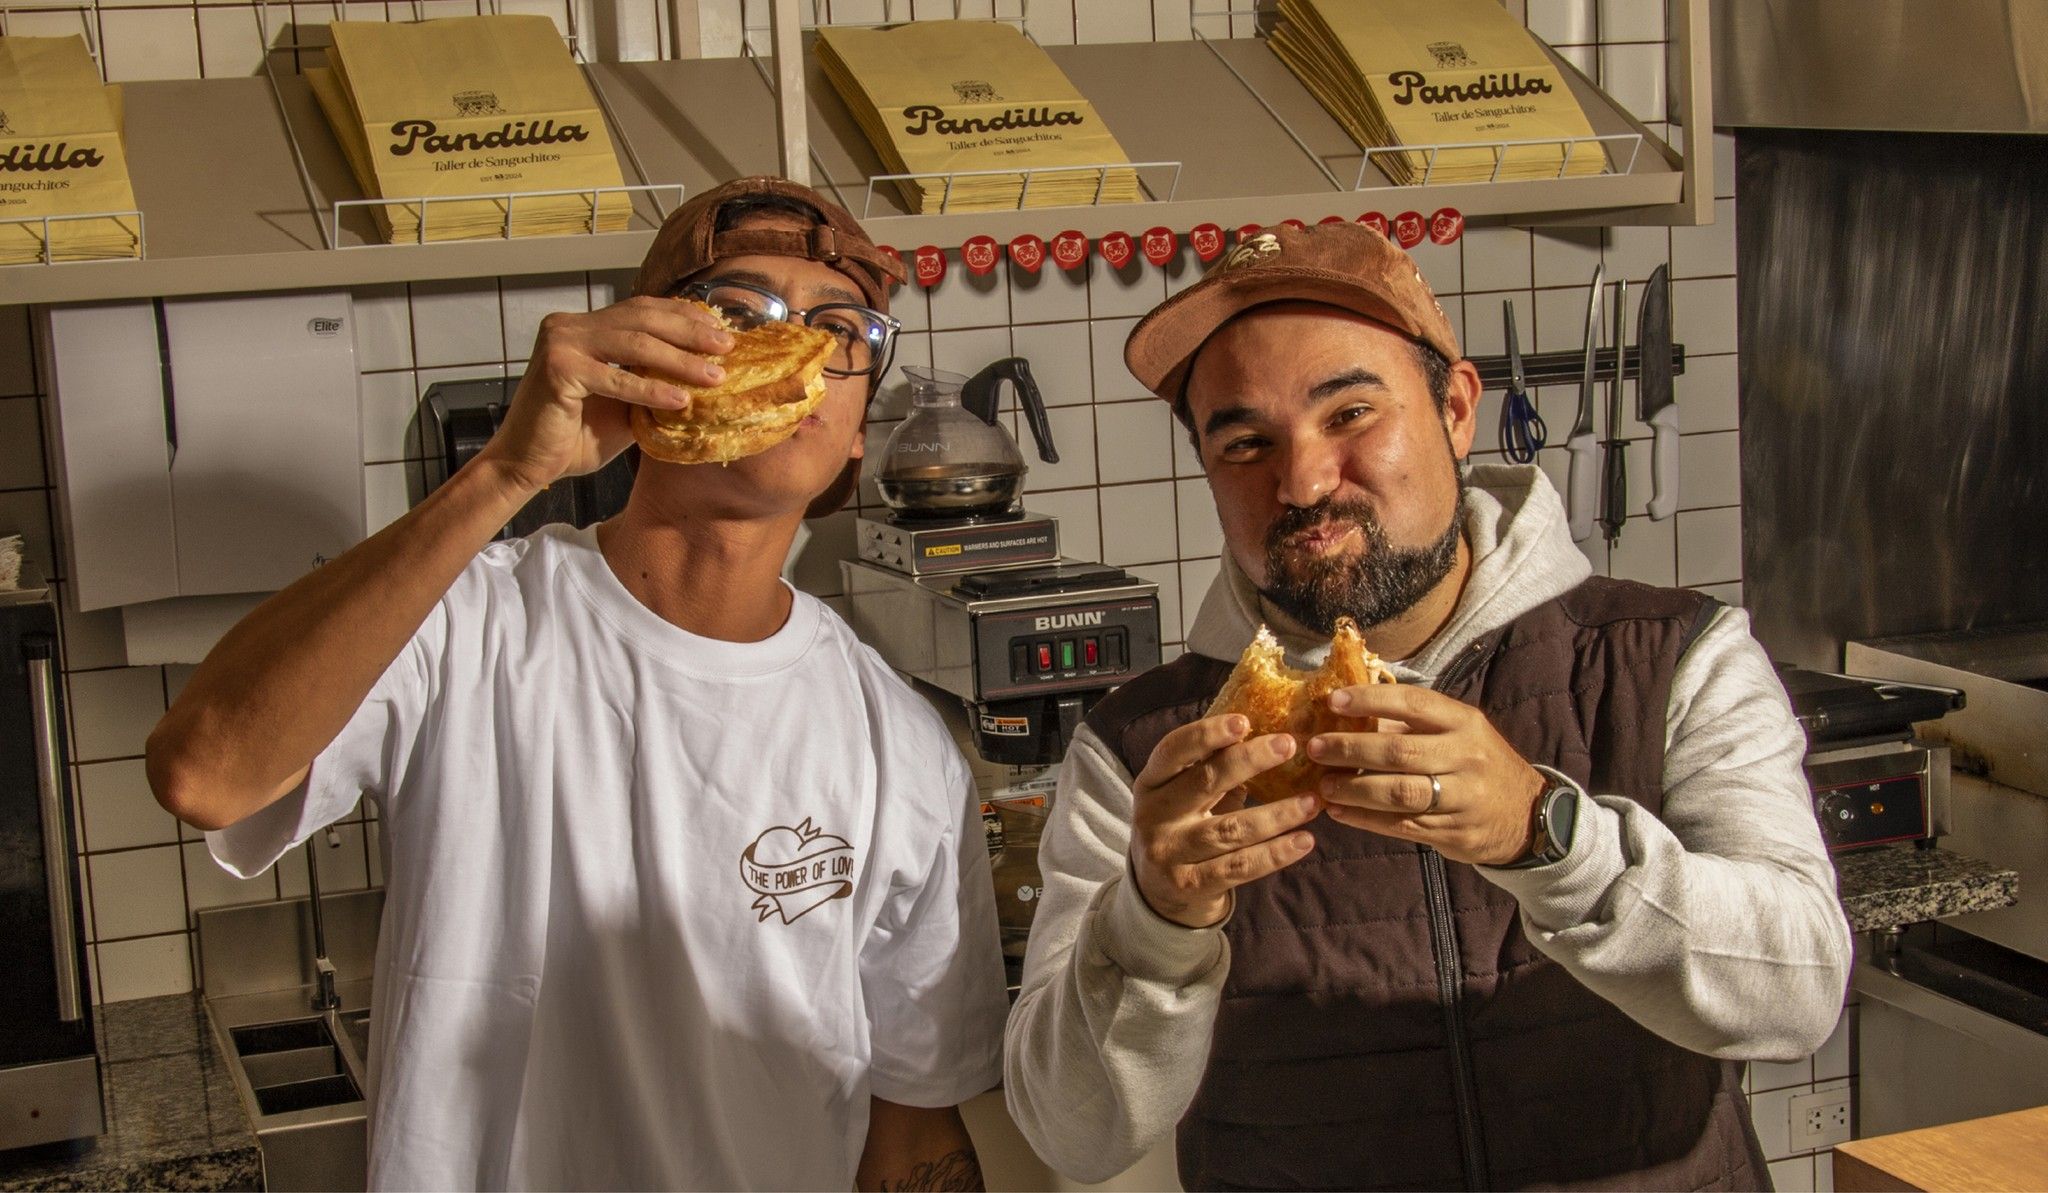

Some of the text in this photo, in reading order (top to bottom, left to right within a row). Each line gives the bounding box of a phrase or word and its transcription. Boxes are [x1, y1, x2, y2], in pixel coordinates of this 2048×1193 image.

[1389, 71, 1552, 105] Pandilla
[903, 105, 1084, 135] Pandilla
[1432, 104, 1536, 123] Taller de Sanguchitos
[390, 119, 589, 156] Pandilla
[946, 133, 1062, 151] Taller de Sanguchitos
[0, 143, 104, 172] dilla
[432, 153, 560, 172] Taller de Sanguchitos
[0, 180, 70, 193] nguchitos
[315, 321, 340, 331] Elite
[897, 442, 950, 452] BUNN
[935, 547, 959, 555] CAUTION
[964, 542, 988, 551] WARMERS
[1000, 539, 1026, 548] SURFACES
[1035, 612, 1102, 631] BUNN
[749, 865, 769, 889] THE
[775, 867, 807, 890] POWER
[813, 860, 826, 880] OF
